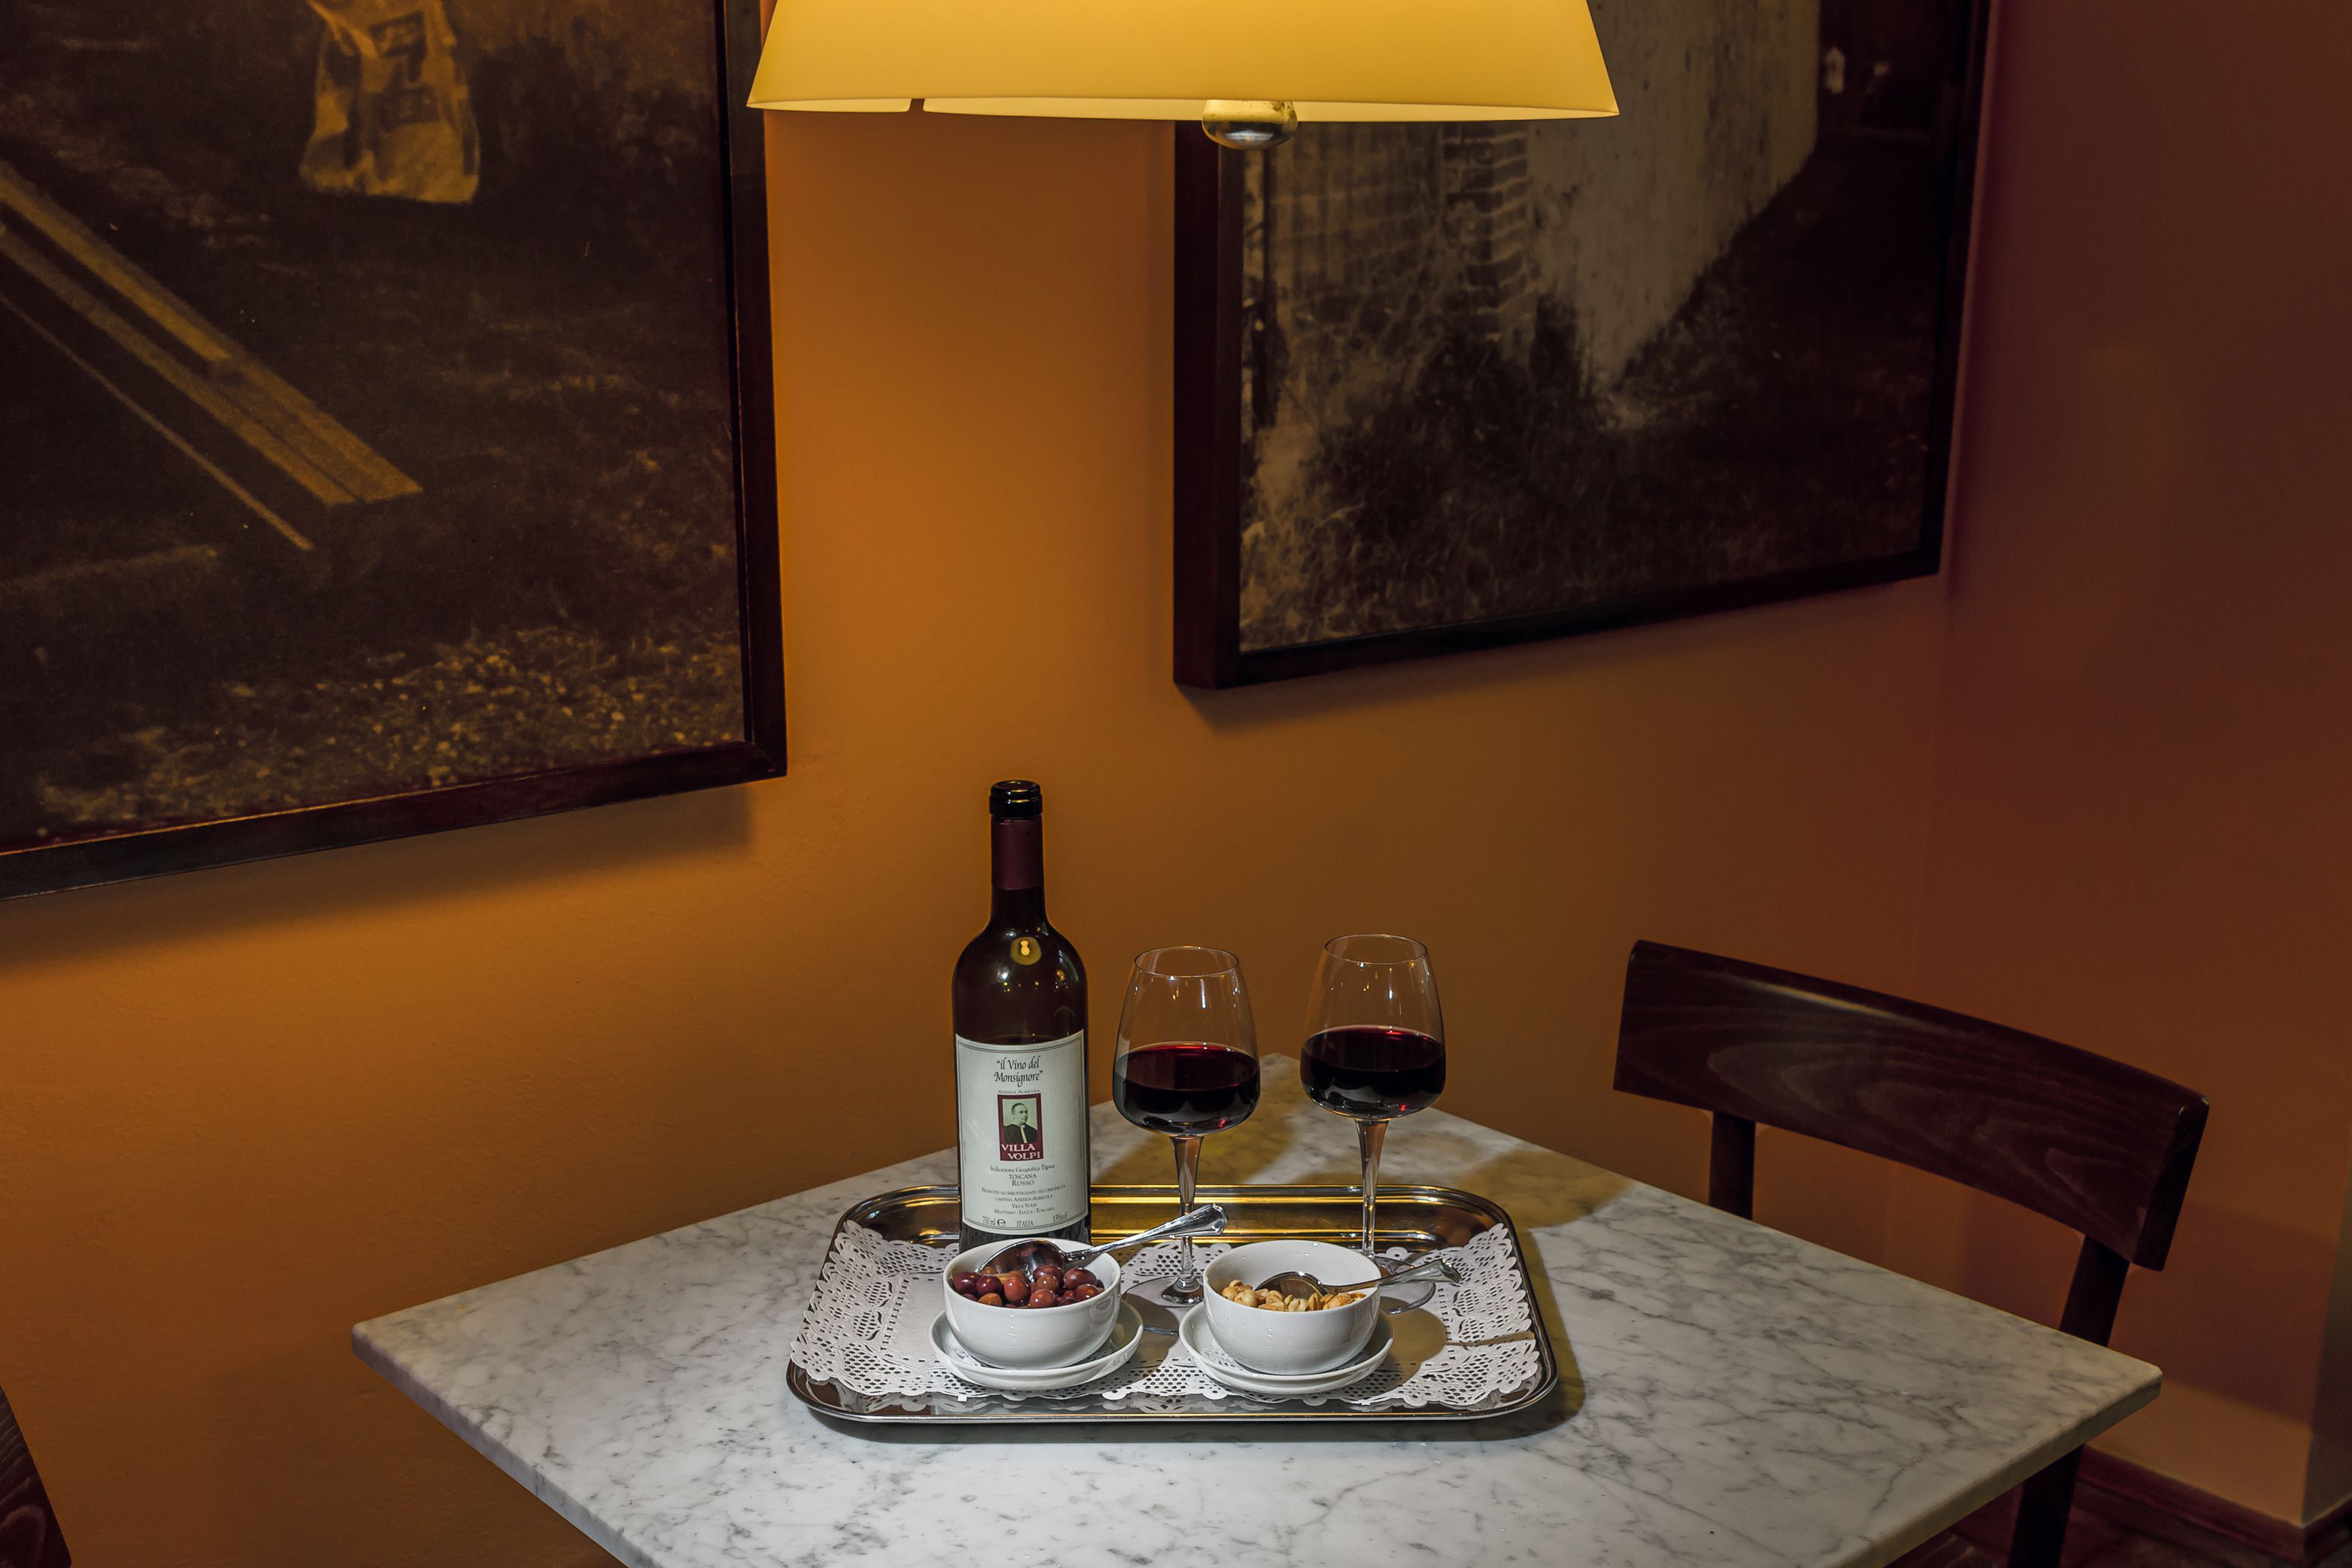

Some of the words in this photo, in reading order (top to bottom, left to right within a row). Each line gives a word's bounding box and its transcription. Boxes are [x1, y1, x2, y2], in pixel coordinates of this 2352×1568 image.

[1008, 1059, 1027, 1070] Vino
[1028, 1055, 1041, 1069] del
[1001, 1143, 1036, 1152] VILLA
[1007, 1152, 1041, 1161] VOLPI
